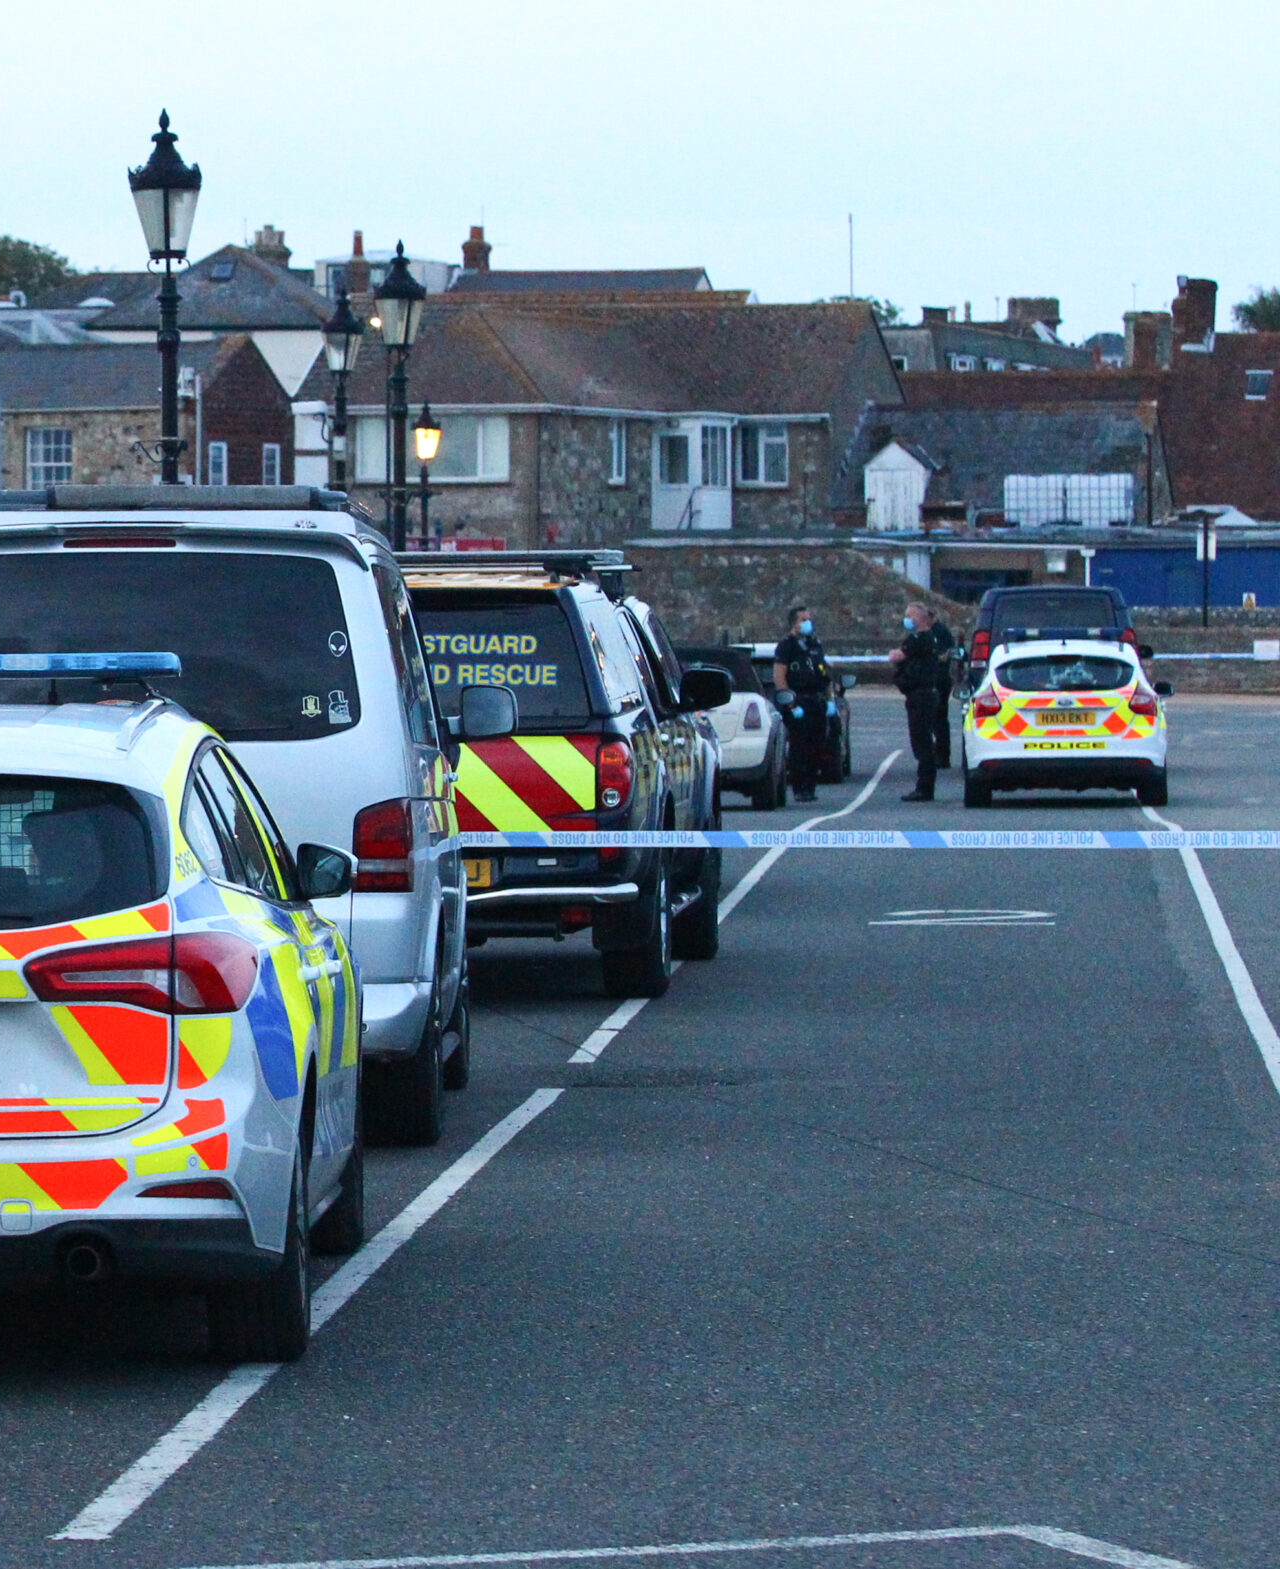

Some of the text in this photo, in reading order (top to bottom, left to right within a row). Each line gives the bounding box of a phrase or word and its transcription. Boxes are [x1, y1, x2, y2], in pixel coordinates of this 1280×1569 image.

[430, 664, 451, 685] D
[457, 664, 558, 685] RESCUE
[1041, 713, 1089, 724] HX13 EKT
[1023, 742, 1106, 750] POLICE
[460, 832, 494, 844] POLIC
[551, 832, 694, 844] POLICE LINE DO NOT CROSS
[751, 831, 894, 845] POLICE LINE DO NOT CROSS
[951, 832, 1094, 845] POLICE LINE DO NOT CROSS
[1150, 832, 1186, 846] CROSS
[1189, 832, 1210, 846] NOT
[1213, 832, 1228, 846] DO
[1231, 832, 1254, 846] LINE
